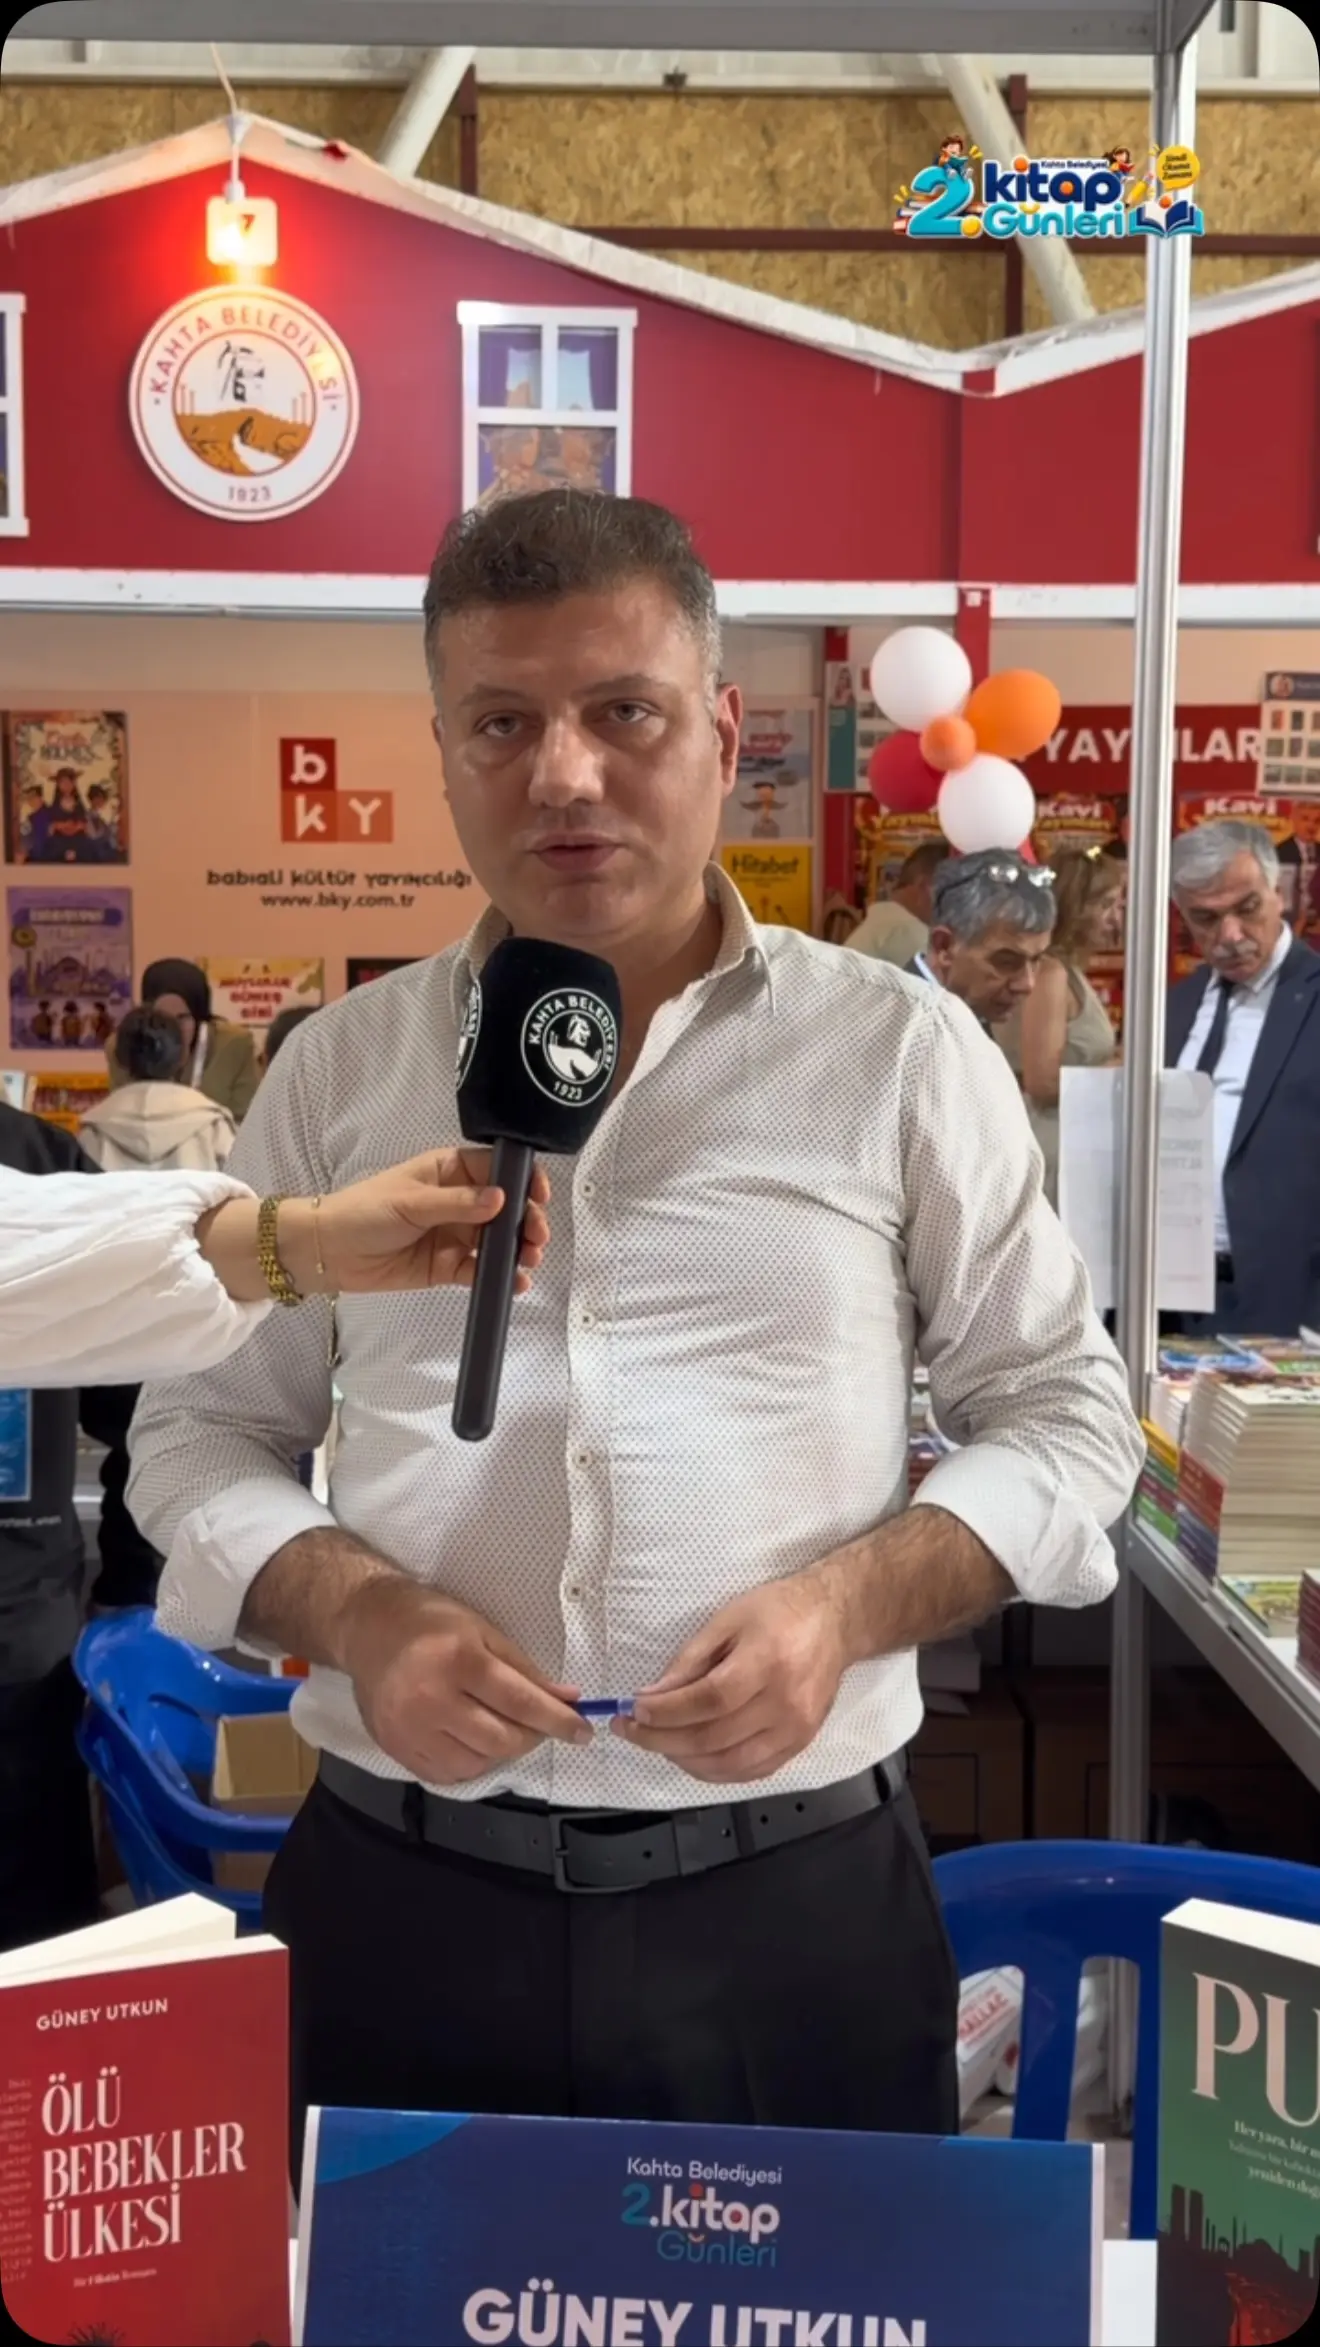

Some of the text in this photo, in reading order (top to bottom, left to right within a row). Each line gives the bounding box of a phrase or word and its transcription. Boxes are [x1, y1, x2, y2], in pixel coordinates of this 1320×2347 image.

[149, 306, 344, 401] KAHTA BELEDİYSİ
[227, 486, 272, 503] 1923
[1043, 728, 1261, 763] YAYLAR
[1204, 798, 1277, 816] Kavi
[290, 870, 357, 887] kültür
[261, 893, 416, 911] www.bky.com.tr
[528, 999, 566, 1045] KAHTA
[554, 1080, 583, 1101] 1923
[36, 1997, 169, 2031] GÜNEY UTKUN
[41, 2065, 121, 2138] ÖLÜ
[43, 2121, 248, 2201] BEBEKLER
[626, 2156, 783, 2187] Kahta Belediyesi
[43, 2181, 182, 2263] ÜLKESİ
[656, 2229, 778, 2269] Günleri
[462, 2277, 694, 2347] GÜNEY
